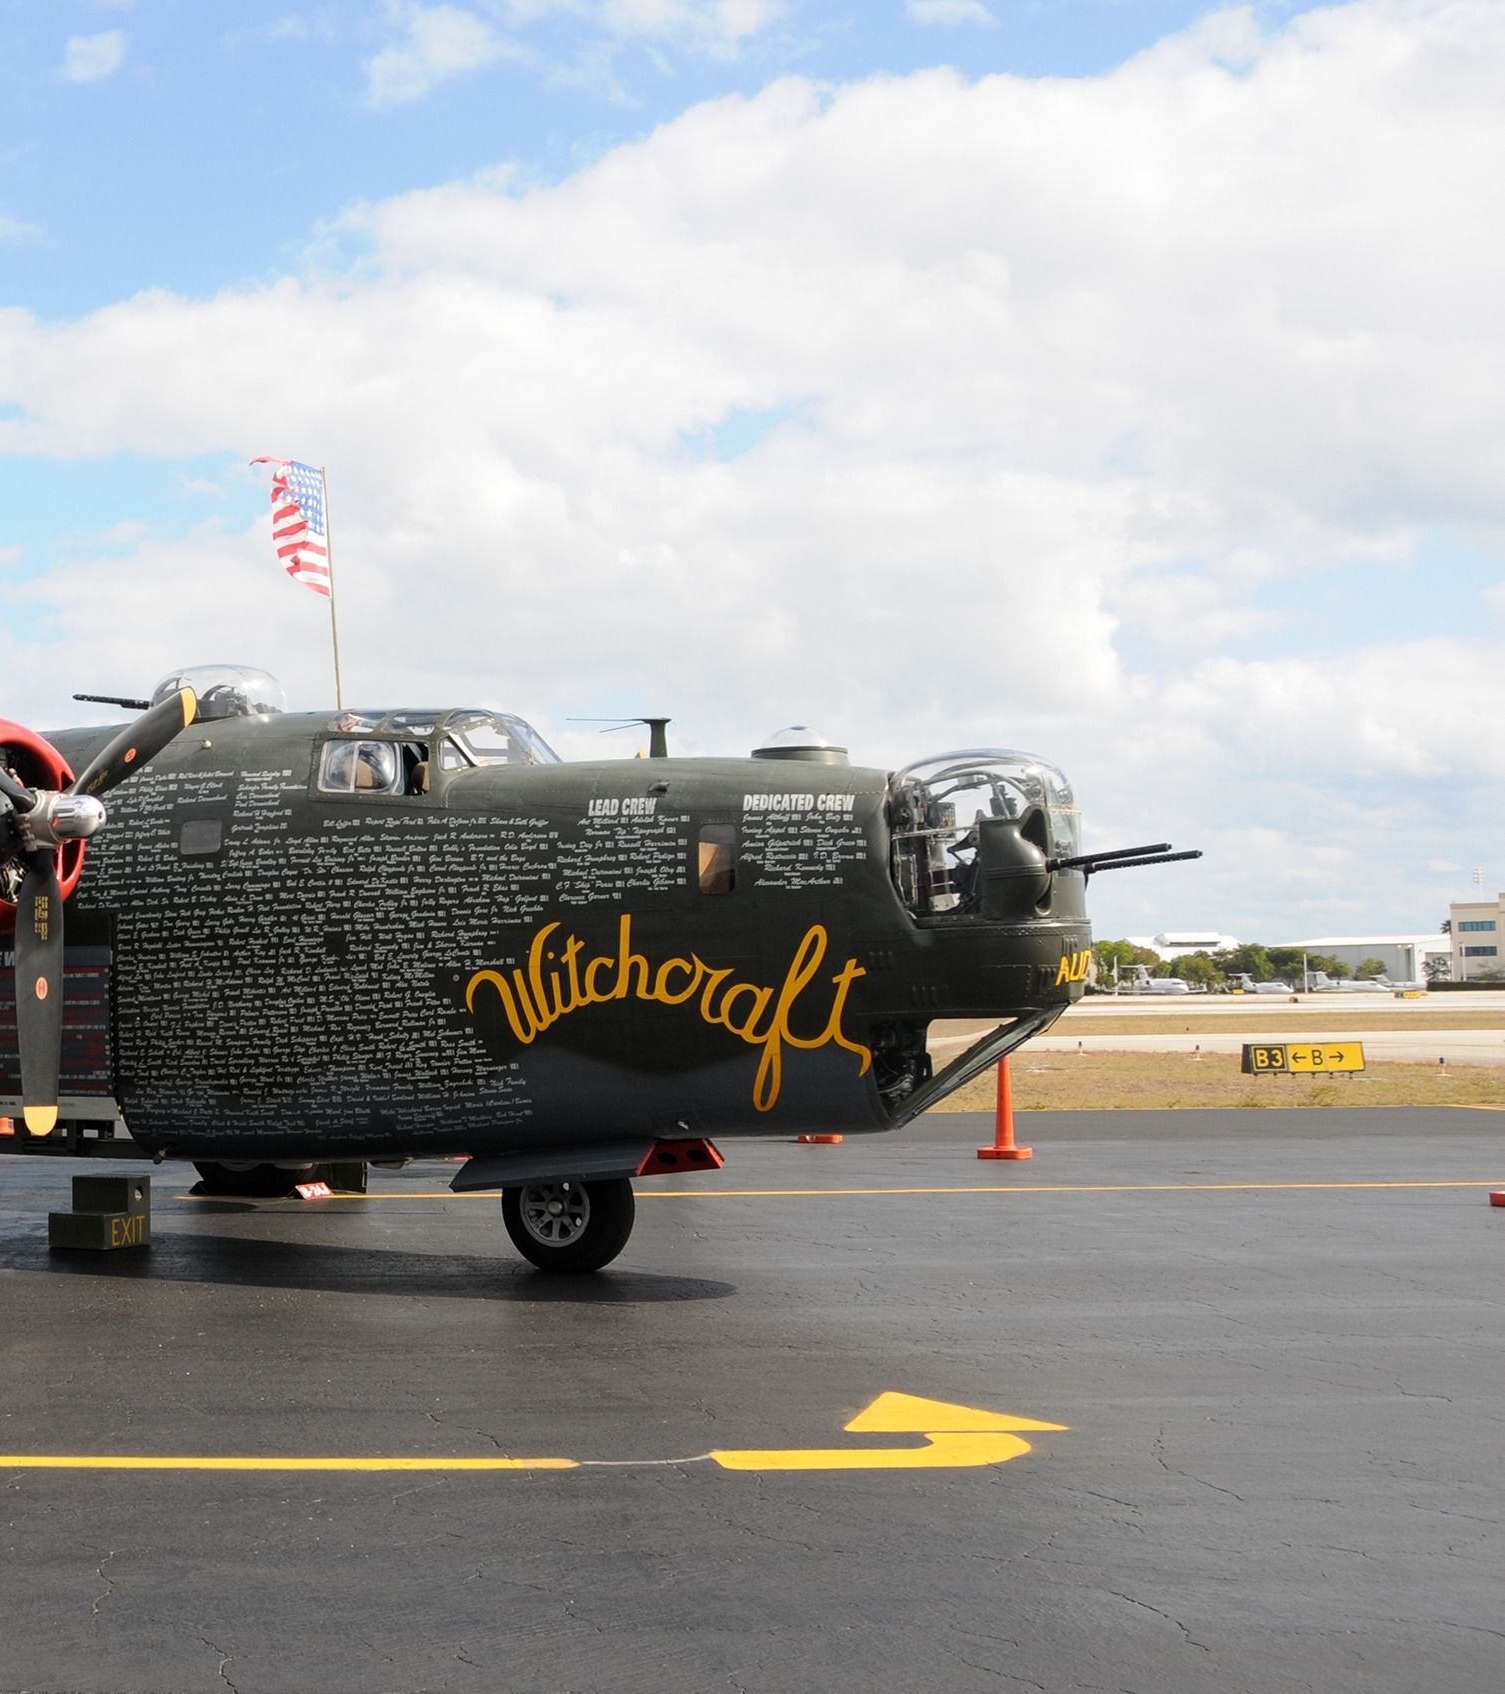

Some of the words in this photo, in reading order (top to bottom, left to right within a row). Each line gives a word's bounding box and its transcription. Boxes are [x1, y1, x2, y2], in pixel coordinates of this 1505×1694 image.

[588, 799, 619, 816] LEAD
[622, 798, 657, 815] CREW
[743, 794, 814, 811] DEDICATED
[817, 794, 855, 811] CREW
[742, 814, 763, 822] James
[806, 812, 822, 821] John
[636, 866, 656, 875] Joseph
[465, 913, 872, 1112] Witchcraft
[1255, 1049, 1283, 1067] B3
[1311, 1050, 1323, 1065] B
[112, 1216, 146, 1246] EXIT
